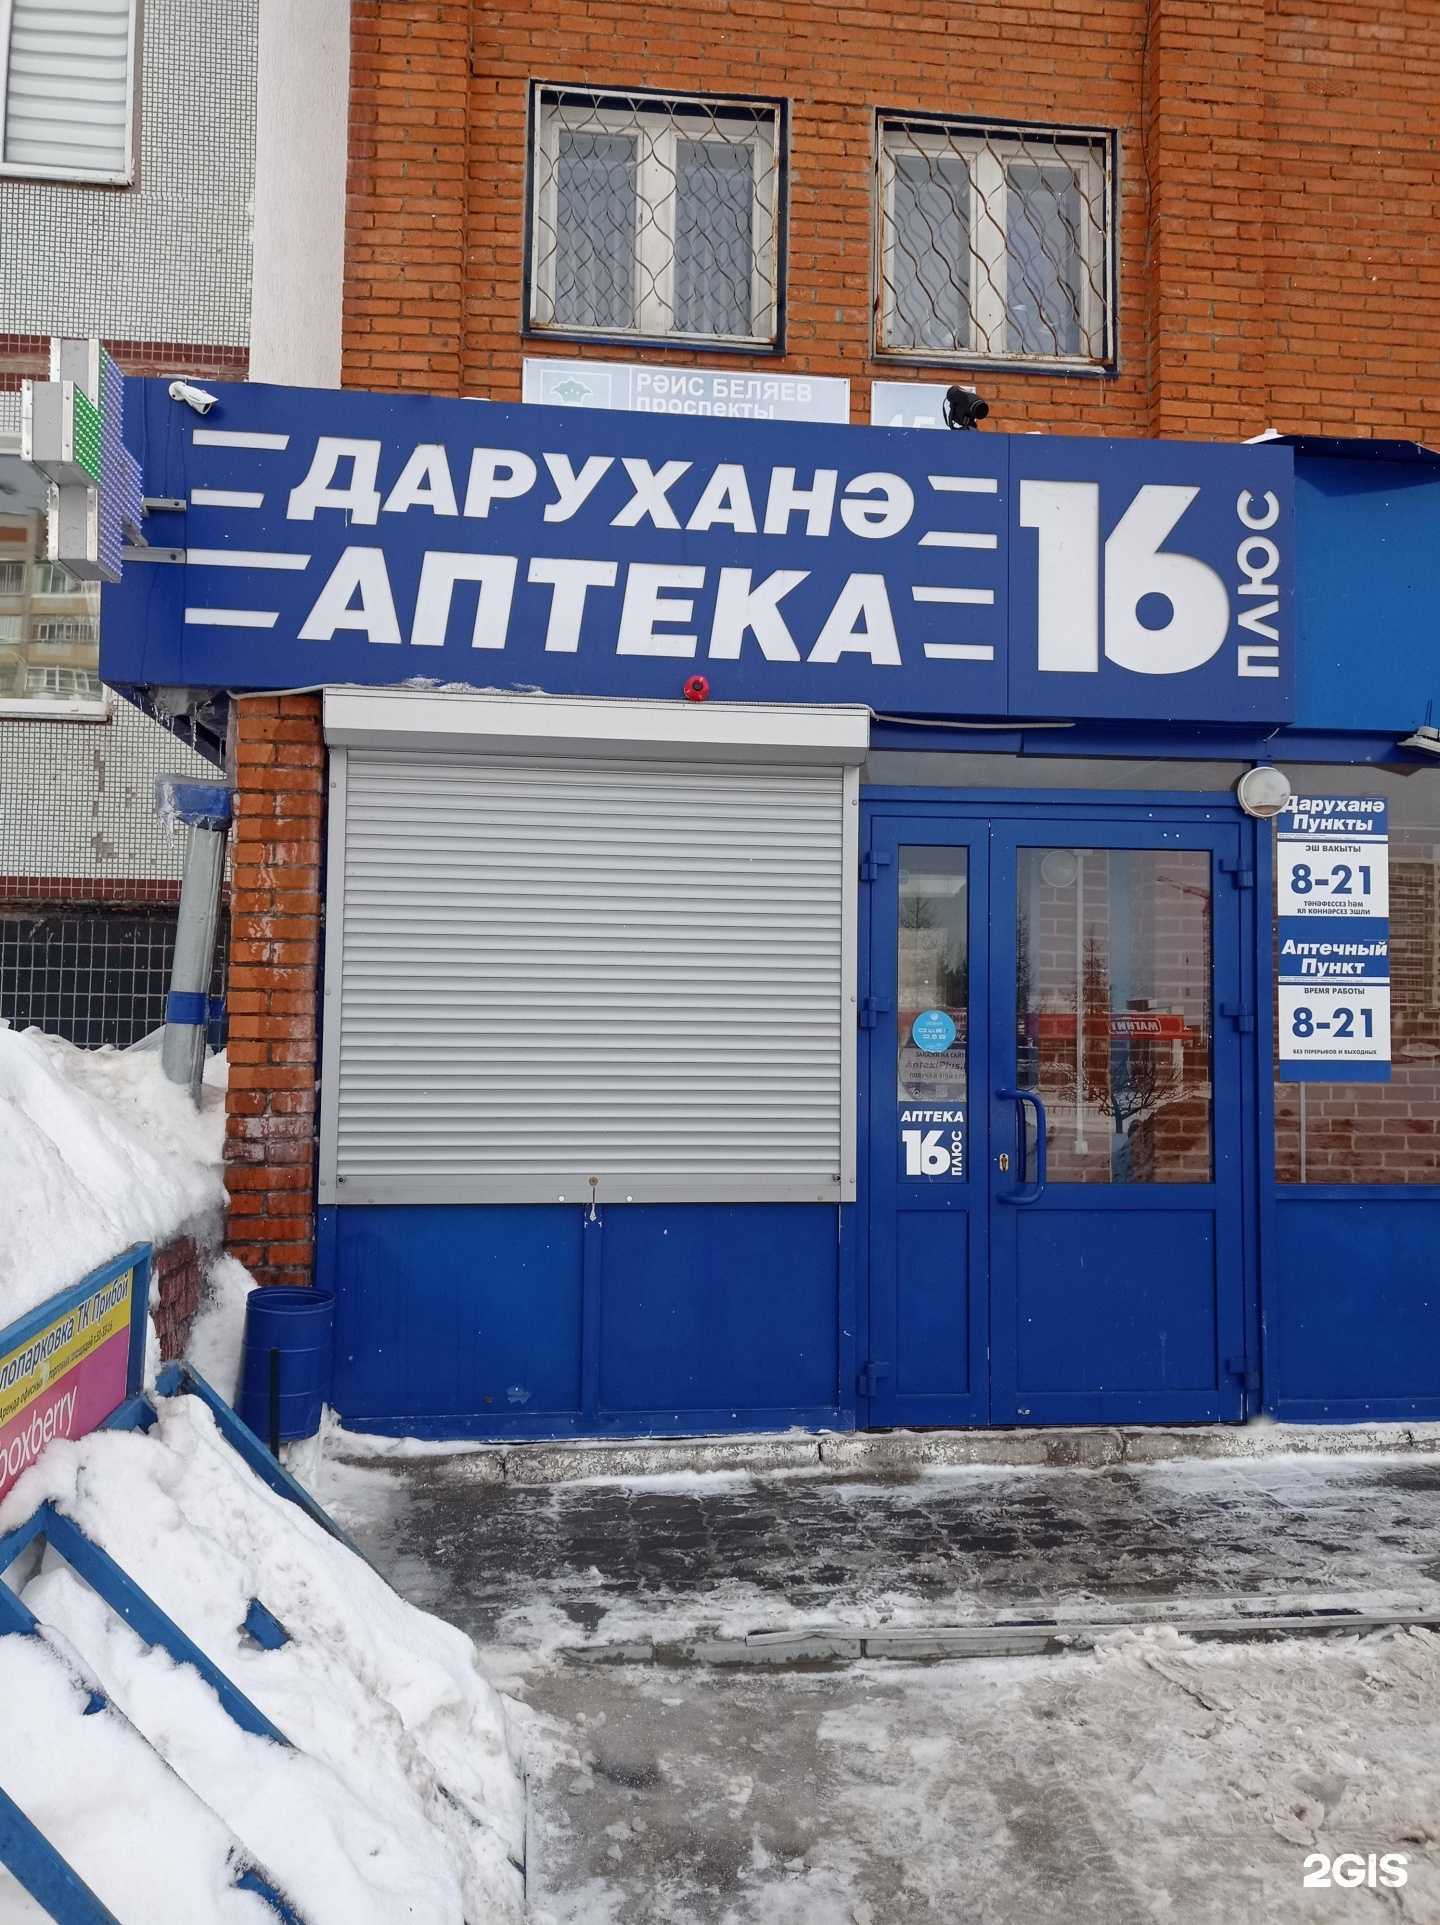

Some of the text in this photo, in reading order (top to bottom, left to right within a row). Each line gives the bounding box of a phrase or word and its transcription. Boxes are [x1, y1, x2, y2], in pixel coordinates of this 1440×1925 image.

[636, 373, 813, 402] РӘИС БЕЛЯЕВ
[286, 436, 915, 539] ДАРУХАНӘ
[1019, 480, 1230, 675] 16
[1236, 488, 1280, 678] ПЛЮС
[297, 546, 902, 666] АПТЕКА
[1279, 796, 1385, 814] Даруханә
[1292, 814, 1373, 832] Пункты
[1322, 845, 1361, 853] ВАКЫТЫ
[1290, 864, 1371, 895] 8-21
[1281, 940, 1388, 957] Аптечный
[1301, 958, 1365, 976] Пункт
[1304, 987, 1330, 995] ВРЕМЯ
[1292, 1007, 1373, 1038] 8-21
[901, 1110, 964, 1122] АПТЕКА
[902, 1130, 951, 1175] 16
[951, 1130, 962, 1176] ПЛЮС
[77, 1299, 91, 1332] ТК
[92, 1271, 129, 1321] Прибой
